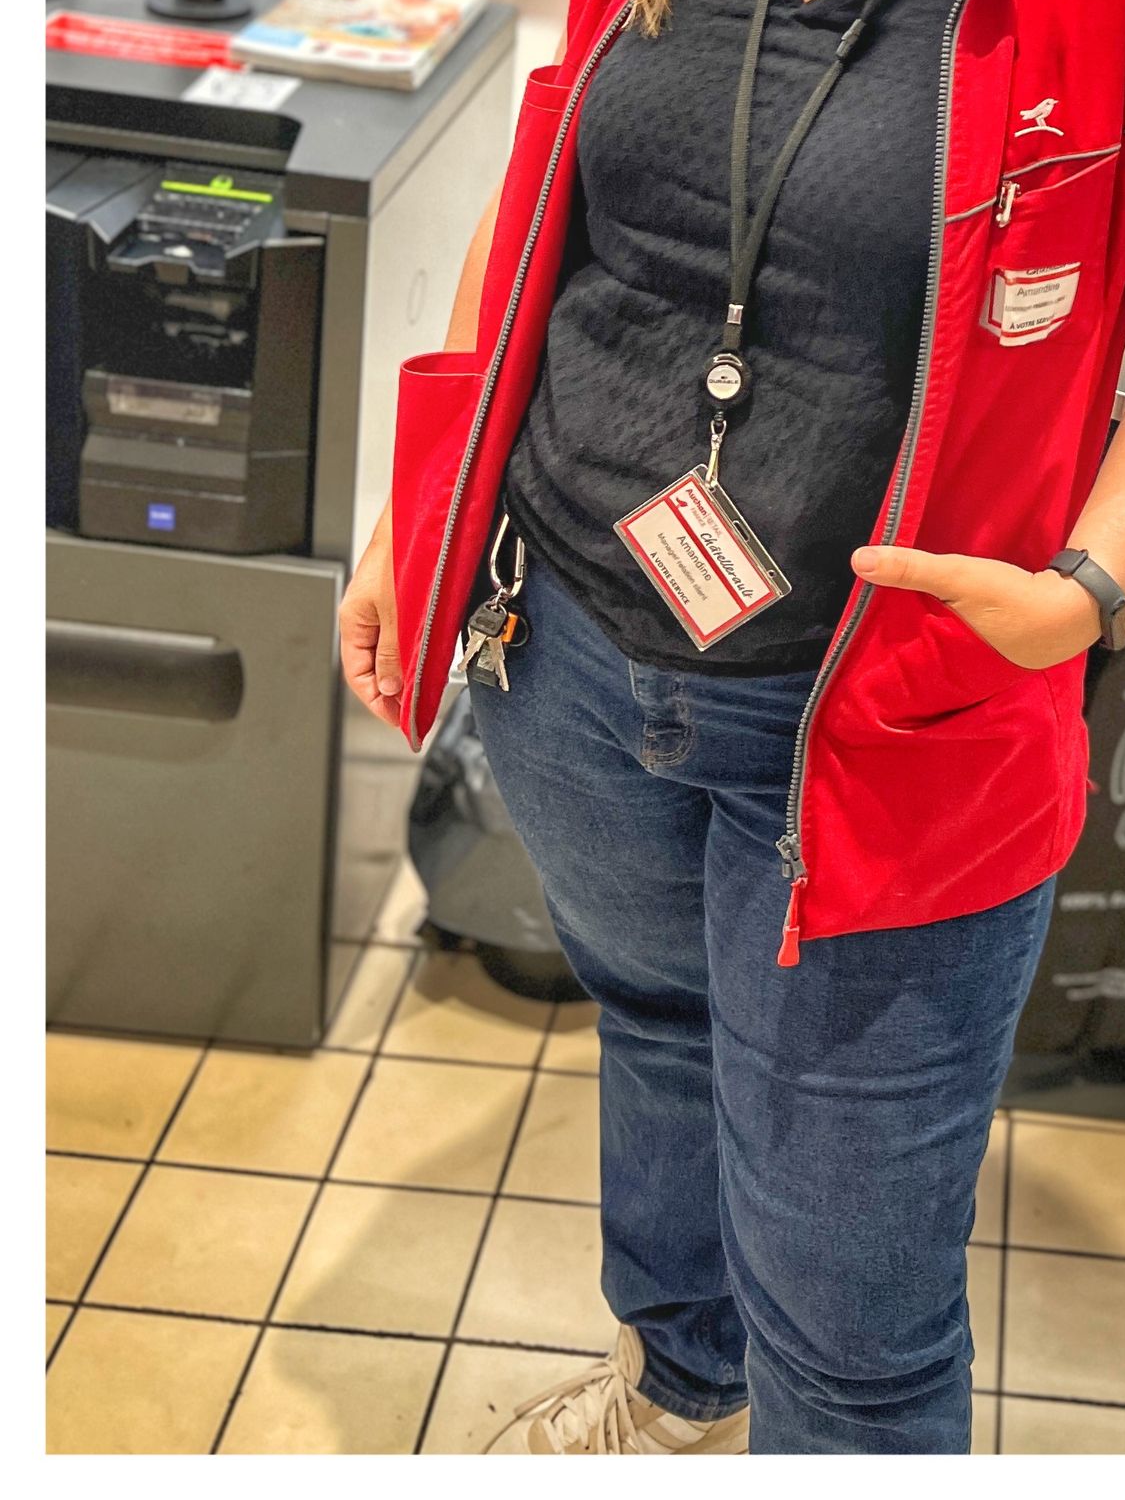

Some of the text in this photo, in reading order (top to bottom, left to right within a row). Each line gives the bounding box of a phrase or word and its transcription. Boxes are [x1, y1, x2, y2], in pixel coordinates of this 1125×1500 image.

[685, 488, 707, 516] Auchan
[655, 558, 672, 579] VOTRE
[669, 578, 690, 605] SERVICE
[677, 535, 712, 582] Amandine
